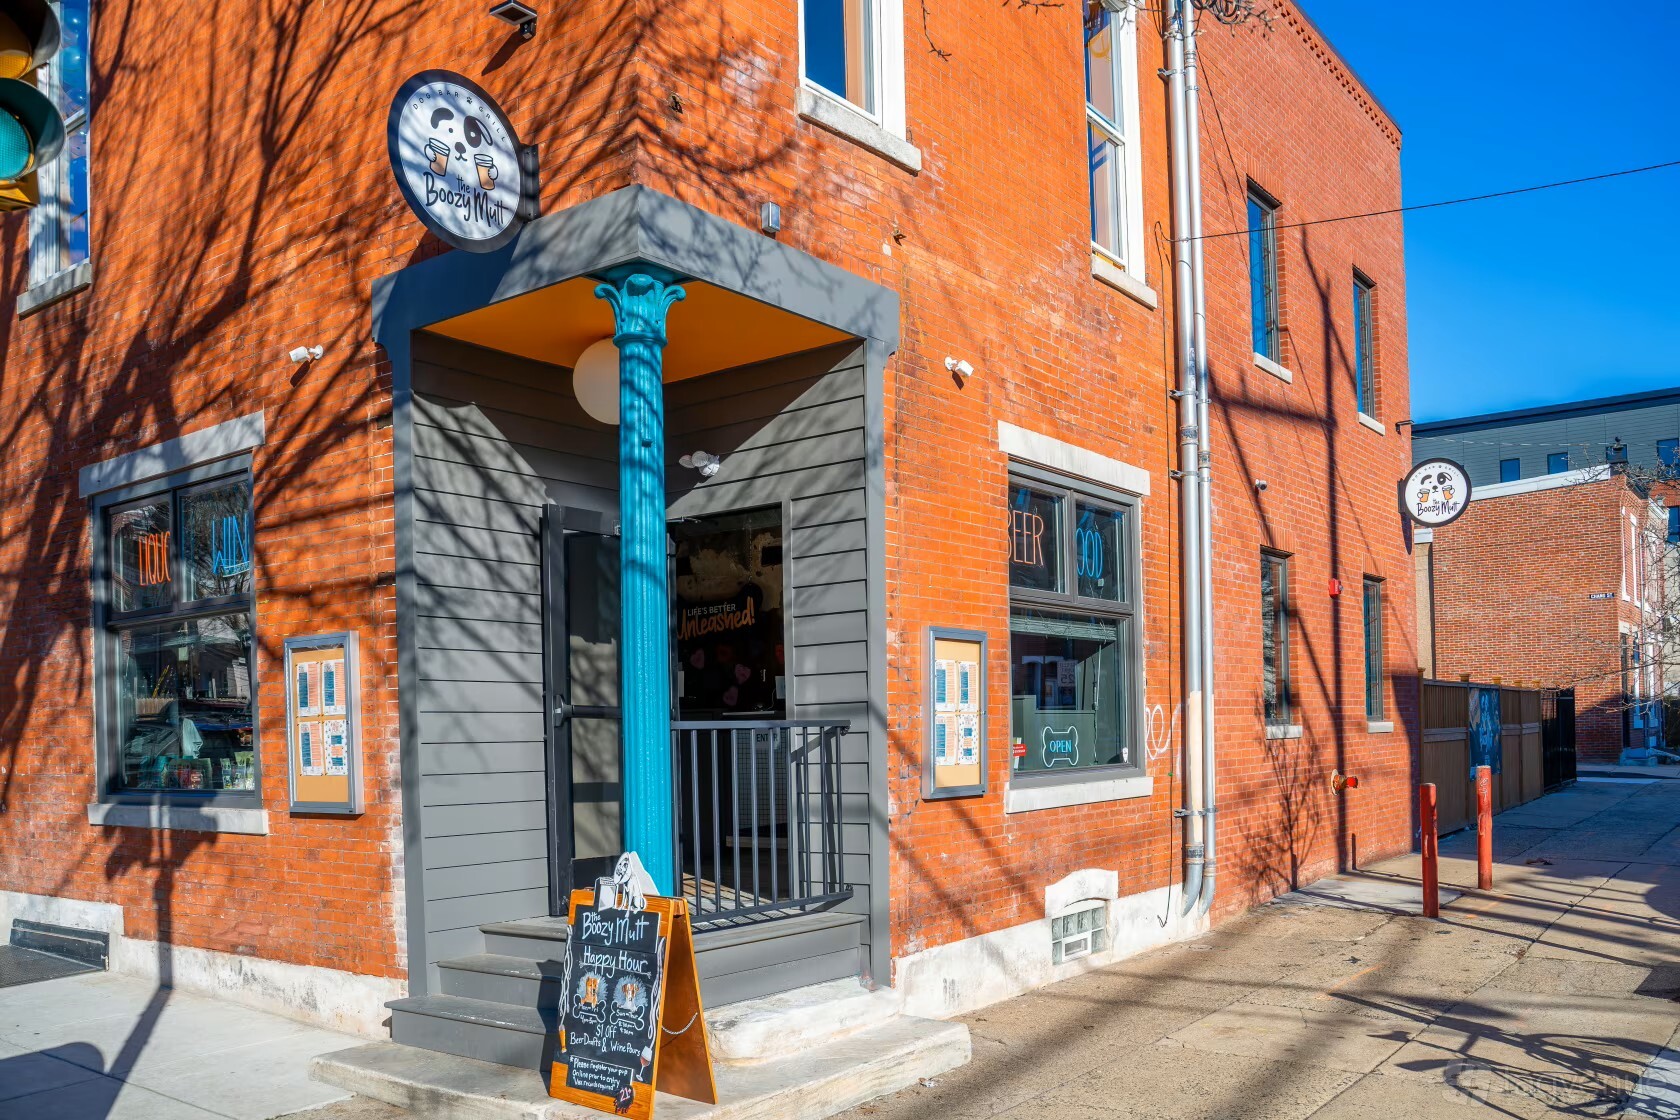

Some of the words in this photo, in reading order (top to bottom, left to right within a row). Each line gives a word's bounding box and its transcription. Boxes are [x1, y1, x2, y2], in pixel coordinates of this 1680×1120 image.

[412, 92, 431, 110] DOG
[438, 89, 459, 98] BAR
[478, 106, 506, 142] GRILL
[456, 174, 470, 193] the
[423, 171, 471, 221] Boozy
[474, 187, 509, 227] Mutt
[1416, 502, 1440, 517] Boozy
[1441, 500, 1460, 514] Mutt
[687, 606, 708, 616] LIFE'S
[709, 602, 736, 614] BETTER
[756, 733, 778, 742] ENTR
[1049, 740, 1072, 753] OPEN
[591, 912, 601, 923] the
[582, 912, 613, 945] Boozy
[615, 915, 650, 945] Mutt
[584, 945, 616, 978] Happy
[619, 950, 648, 973] Hour
[570, 1032, 584, 1045] Beer
[601, 1037, 607, 1052] &
[610, 1041, 626, 1052] Wine
[626, 1042, 641, 1057] Pours
